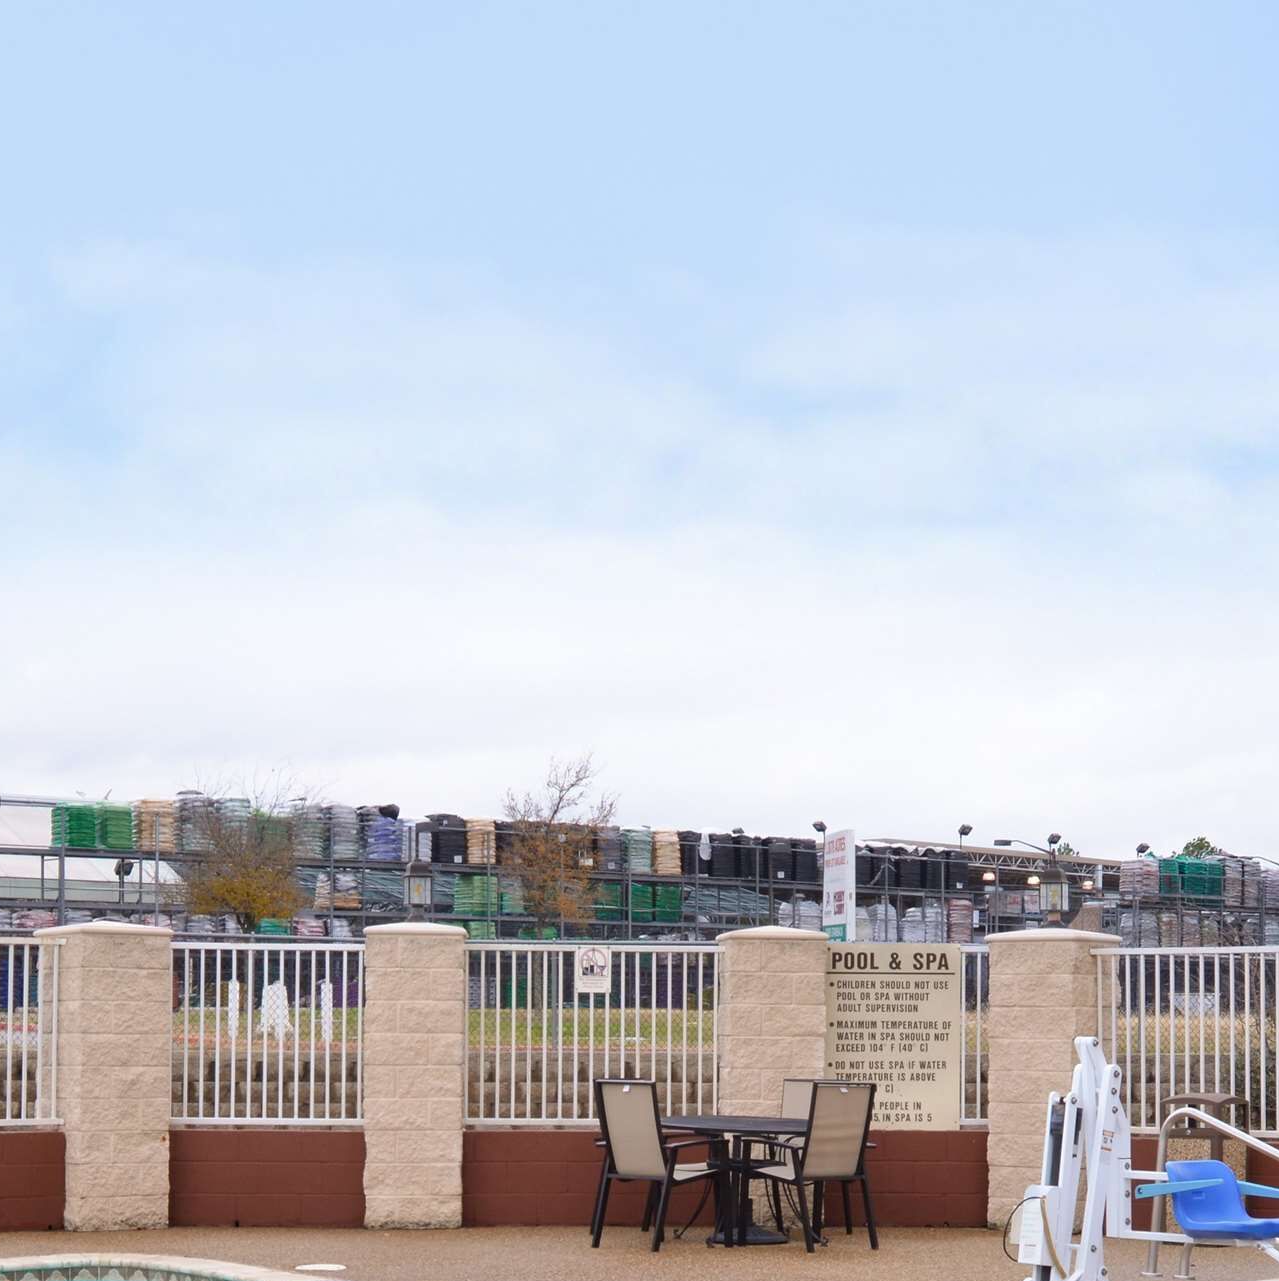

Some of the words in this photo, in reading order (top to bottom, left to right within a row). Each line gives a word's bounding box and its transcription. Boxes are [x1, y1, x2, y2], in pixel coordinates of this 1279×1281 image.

[832, 952, 879, 970] POOL
[889, 952, 901, 970] &
[913, 952, 949, 970] SPA
[836, 981, 876, 989] CHILDREN
[880, 981, 911, 989] SHOULD
[914, 981, 929, 989] NOT
[933, 981, 949, 989] USE
[836, 992, 856, 1000] POOL
[860, 992, 871, 1000] OR
[874, 992, 890, 1000] SPA
[893, 992, 930, 1000] WITHOUT
[837, 1004, 861, 1012] ADULT
[865, 1004, 919, 1012] SUPERVISION
[836, 1021, 877, 1029] MAXIMUM
[881, 1021, 938, 1029] TEMPERATURE
[942, 1021, 952, 1029] OF
[837, 1032, 864, 1040] WATER
[868, 1032, 876, 1040] IN
[880, 1032, 895, 1040] SPA
[899, 1032, 930, 1040] SHOULD
[934, 1032, 950, 1040] NOT
[835, 1044, 866, 1052] EXCEED
[835, 1061, 846, 1070] DO
[849, 1061, 864, 1070] NOT
[868, 1061, 884, 1070] USE
[888, 1061, 904, 1070] SPA
[908, 1061, 915, 1070] IF
[919, 1061, 947, 1070] WATER
[836, 1072, 894, 1081] TEMPERATURE
[898, 1072, 905, 1081] IS
[910, 1072, 936, 1081] ABOVE
[879, 1102, 909, 1110] PEOPLE
[913, 1102, 922, 1110] IN
[882, 1113, 891, 1122] IN
[894, 1113, 911, 1122] SPA
[914, 1113, 923, 1122] IS
[926, 1113, 933, 1122] 5
